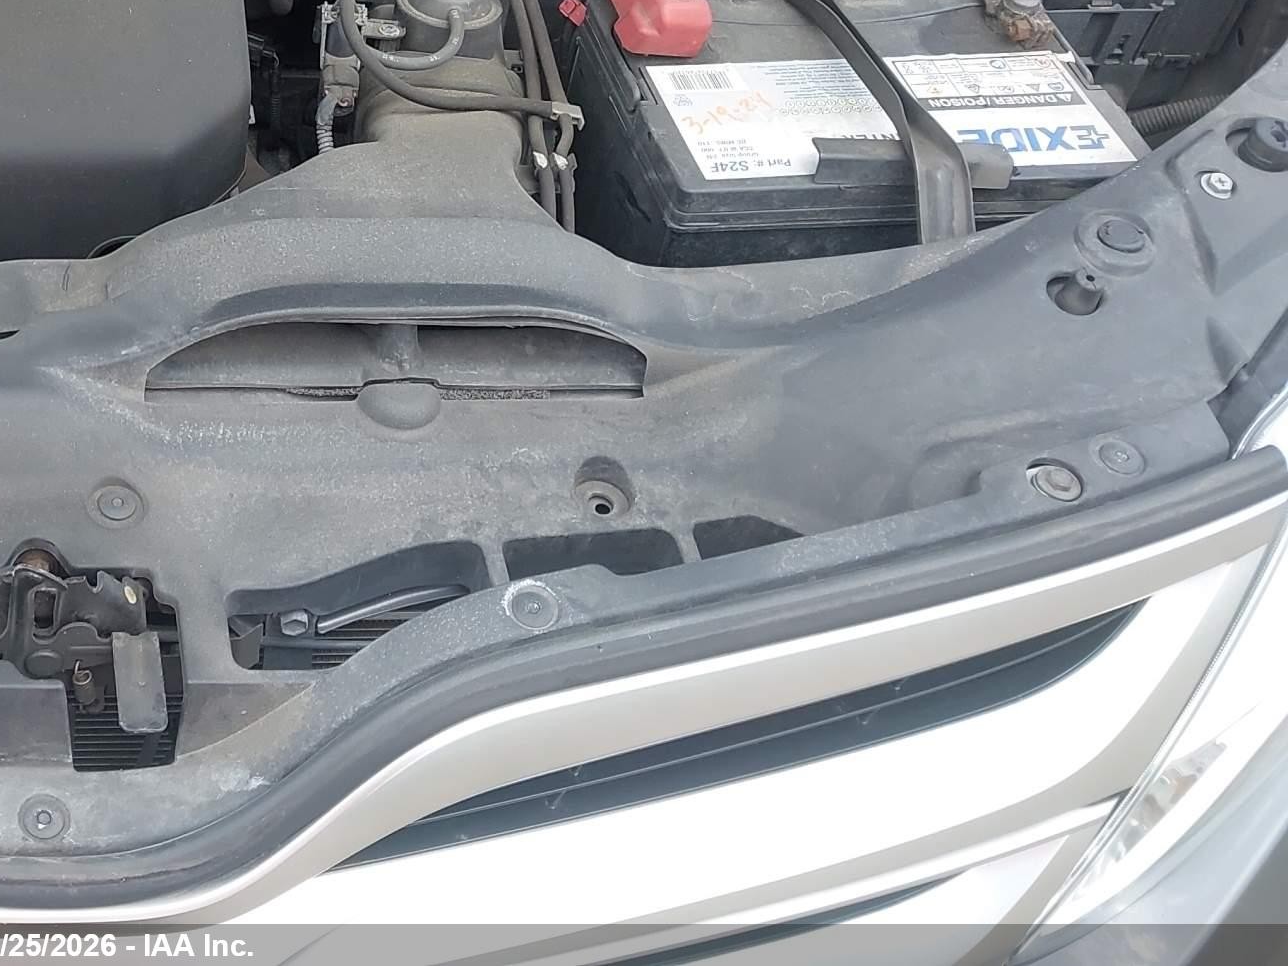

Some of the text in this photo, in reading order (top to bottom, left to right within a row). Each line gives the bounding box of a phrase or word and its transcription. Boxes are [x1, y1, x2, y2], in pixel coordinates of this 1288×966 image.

[992, 94, 1060, 106] DANGER
[957, 124, 1110, 153] EXIDE
[711, 160, 750, 173] S24F
[768, 159, 792, 168] Part
